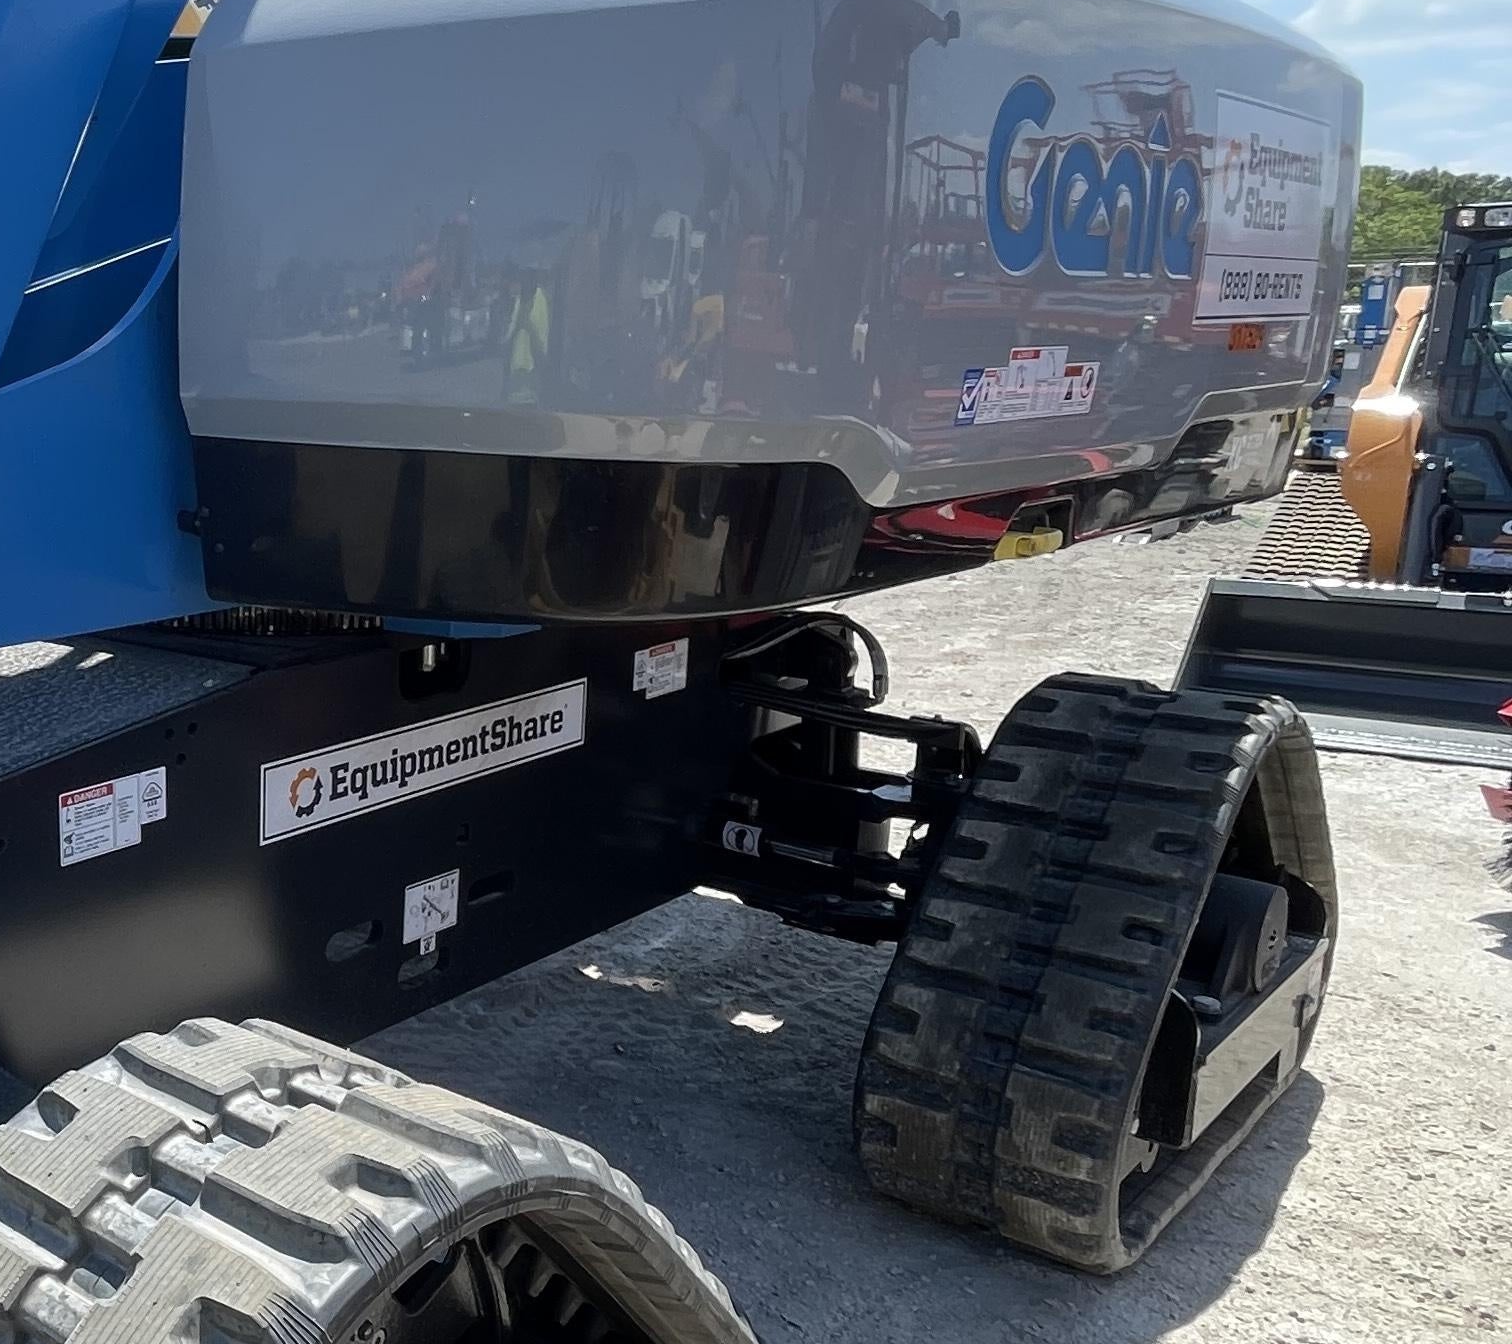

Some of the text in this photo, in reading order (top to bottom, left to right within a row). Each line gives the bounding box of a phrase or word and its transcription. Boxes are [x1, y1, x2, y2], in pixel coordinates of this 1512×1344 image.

[986, 75, 1203, 280] Genie
[1249, 132, 1322, 191] Equipment
[1243, 187, 1287, 232] Share
[329, 708, 564, 802] EquipmentShare
